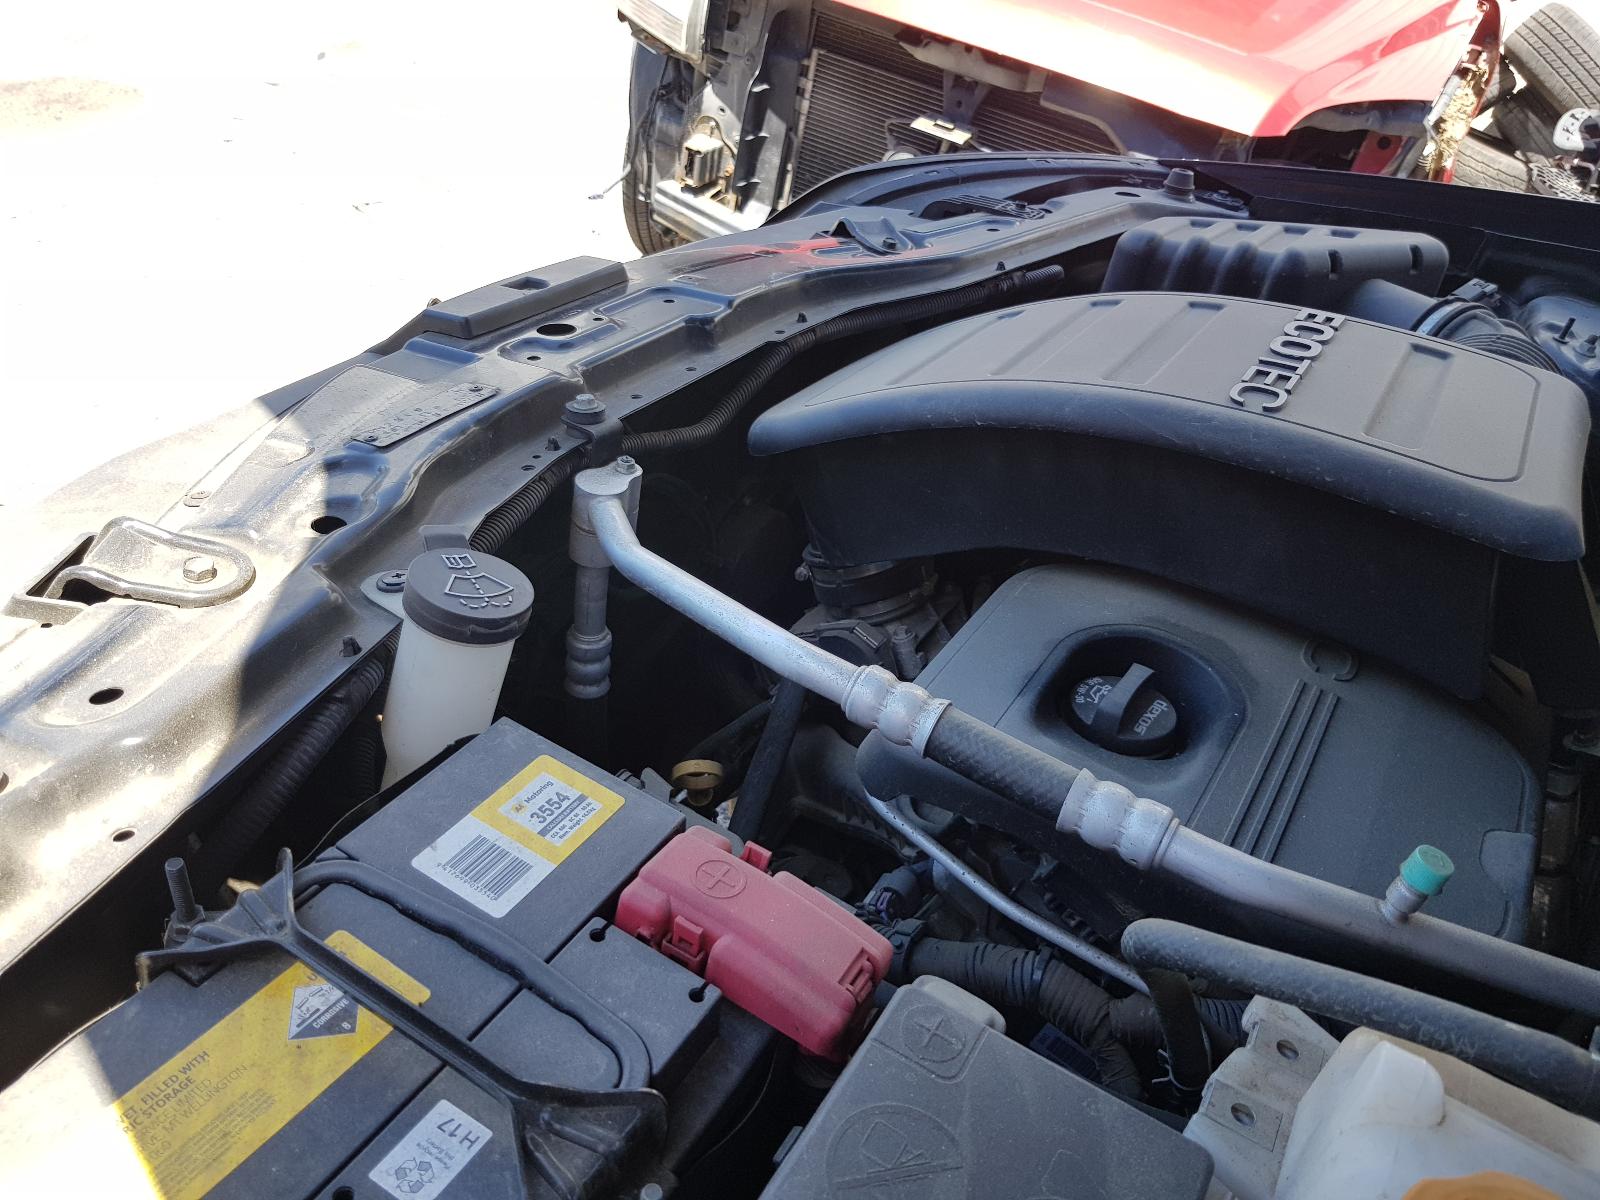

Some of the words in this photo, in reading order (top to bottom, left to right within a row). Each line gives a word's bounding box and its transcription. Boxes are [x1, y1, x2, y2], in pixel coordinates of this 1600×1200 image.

[1229, 309, 1346, 412] ECOTEC
[1133, 699, 1169, 736] dexos
[524, 780, 554, 804] Motoring
[530, 791, 571, 824] 3554
[312, 998, 350, 1029] CORROSIVE
[341, 1021, 351, 1030] 8
[140, 1074, 179, 1105] FILLED
[179, 1051, 210, 1076] WITH
[142, 1076, 196, 1118] STORAGE
